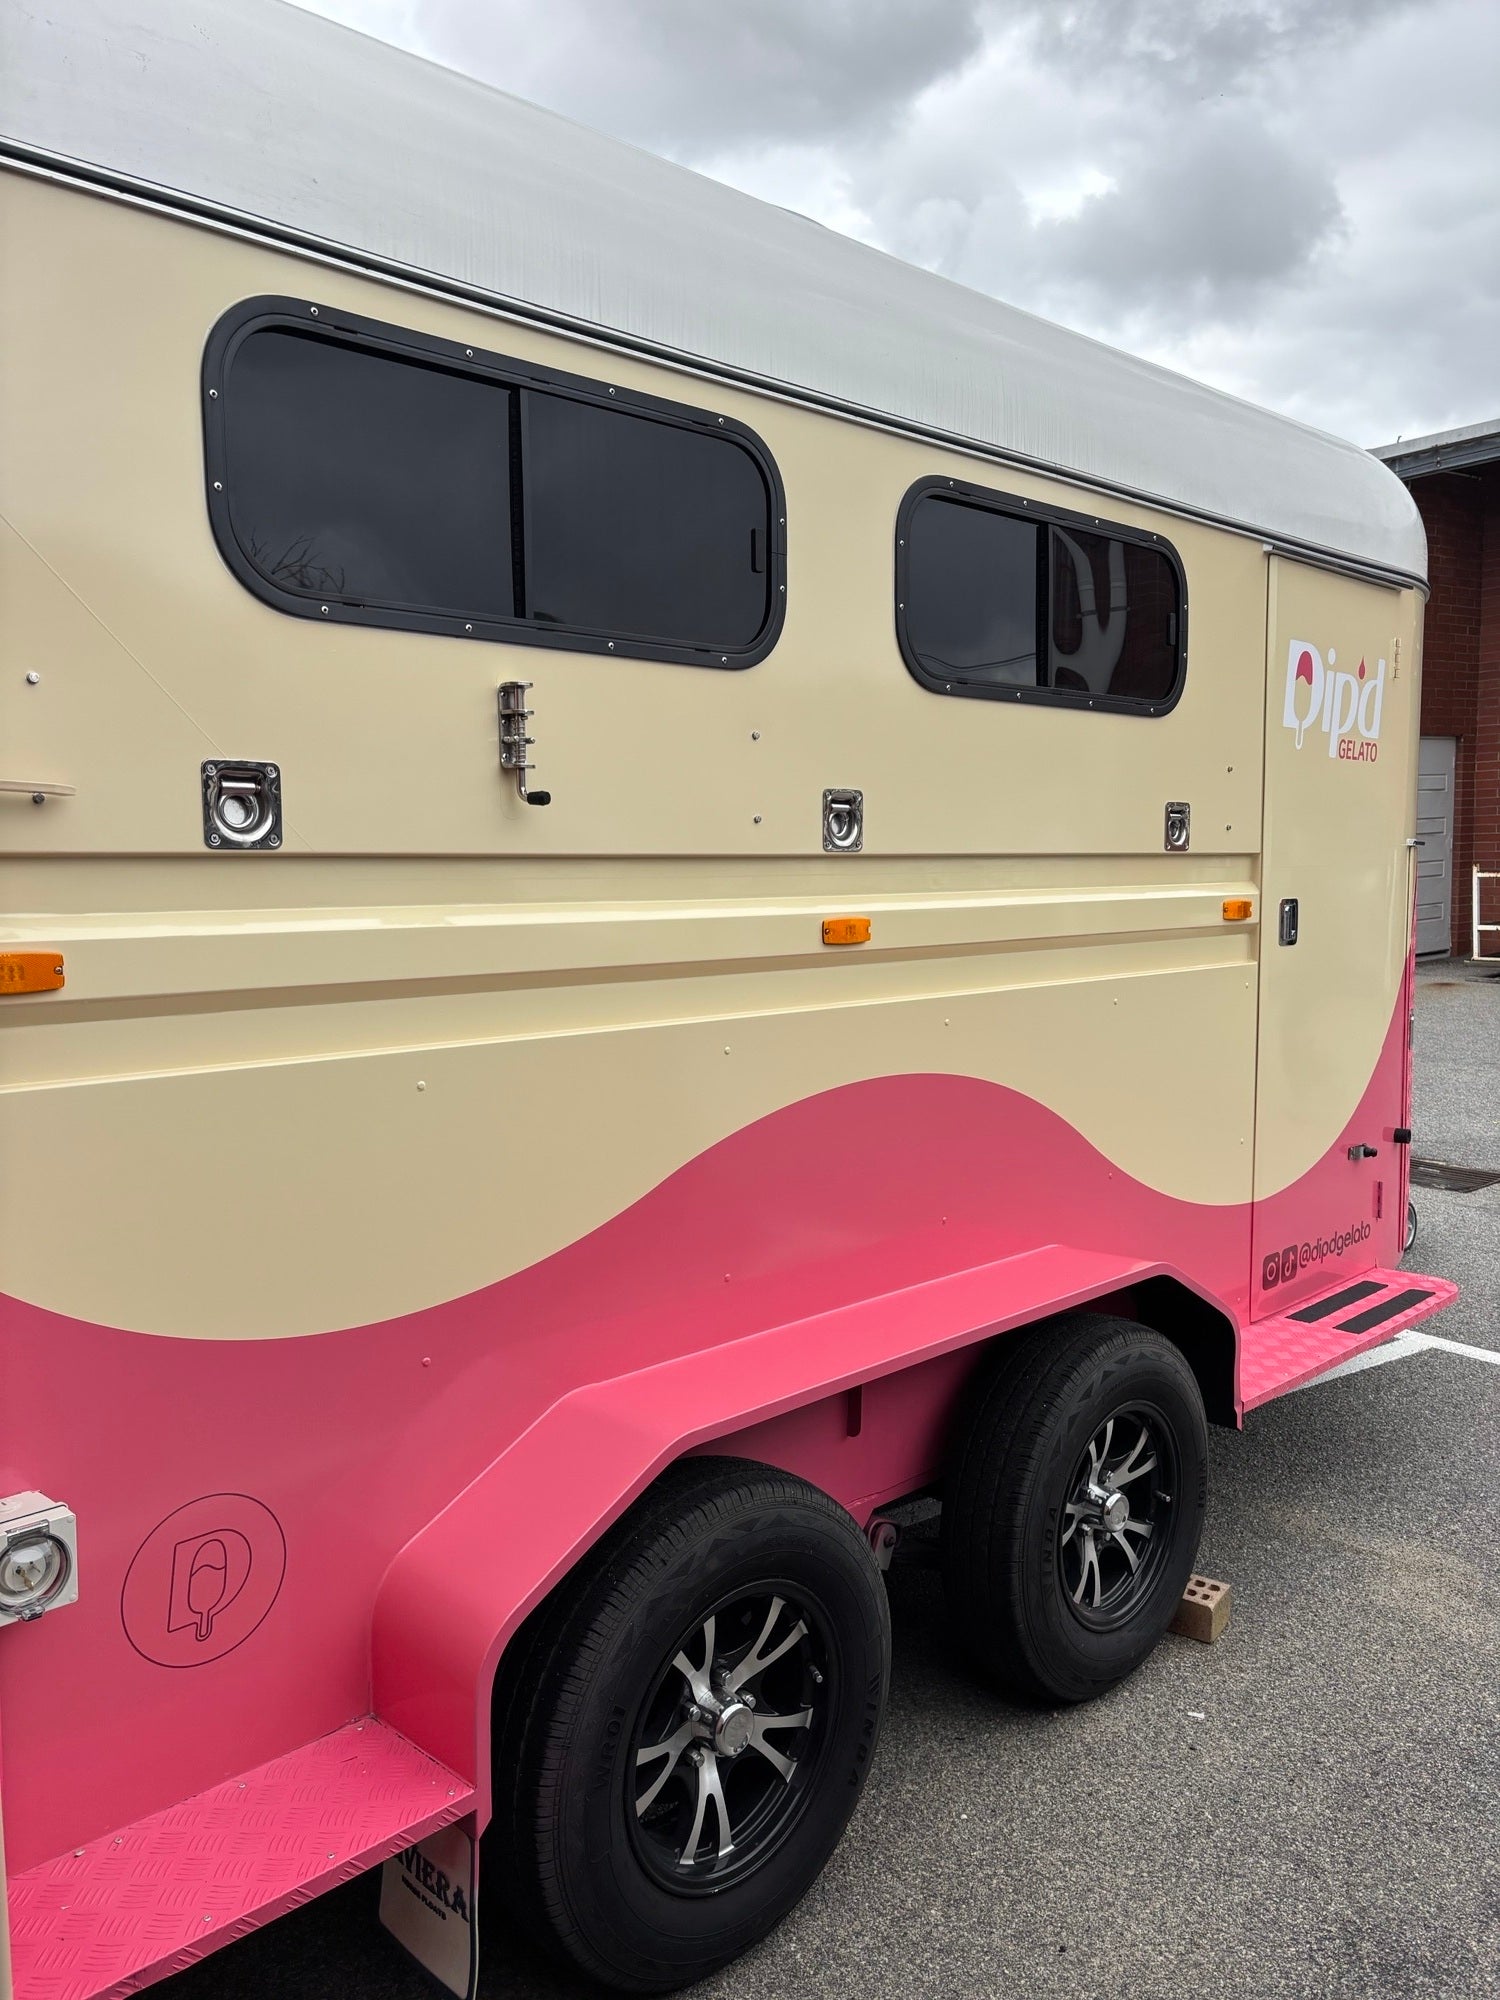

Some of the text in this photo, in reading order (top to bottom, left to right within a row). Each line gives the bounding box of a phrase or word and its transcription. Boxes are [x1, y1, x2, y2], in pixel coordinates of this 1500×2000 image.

[1338, 738, 1378, 763] GELATO
[1299, 1221, 1371, 1269] @dipdgelato
[394, 1845, 469, 1923] VIERA
